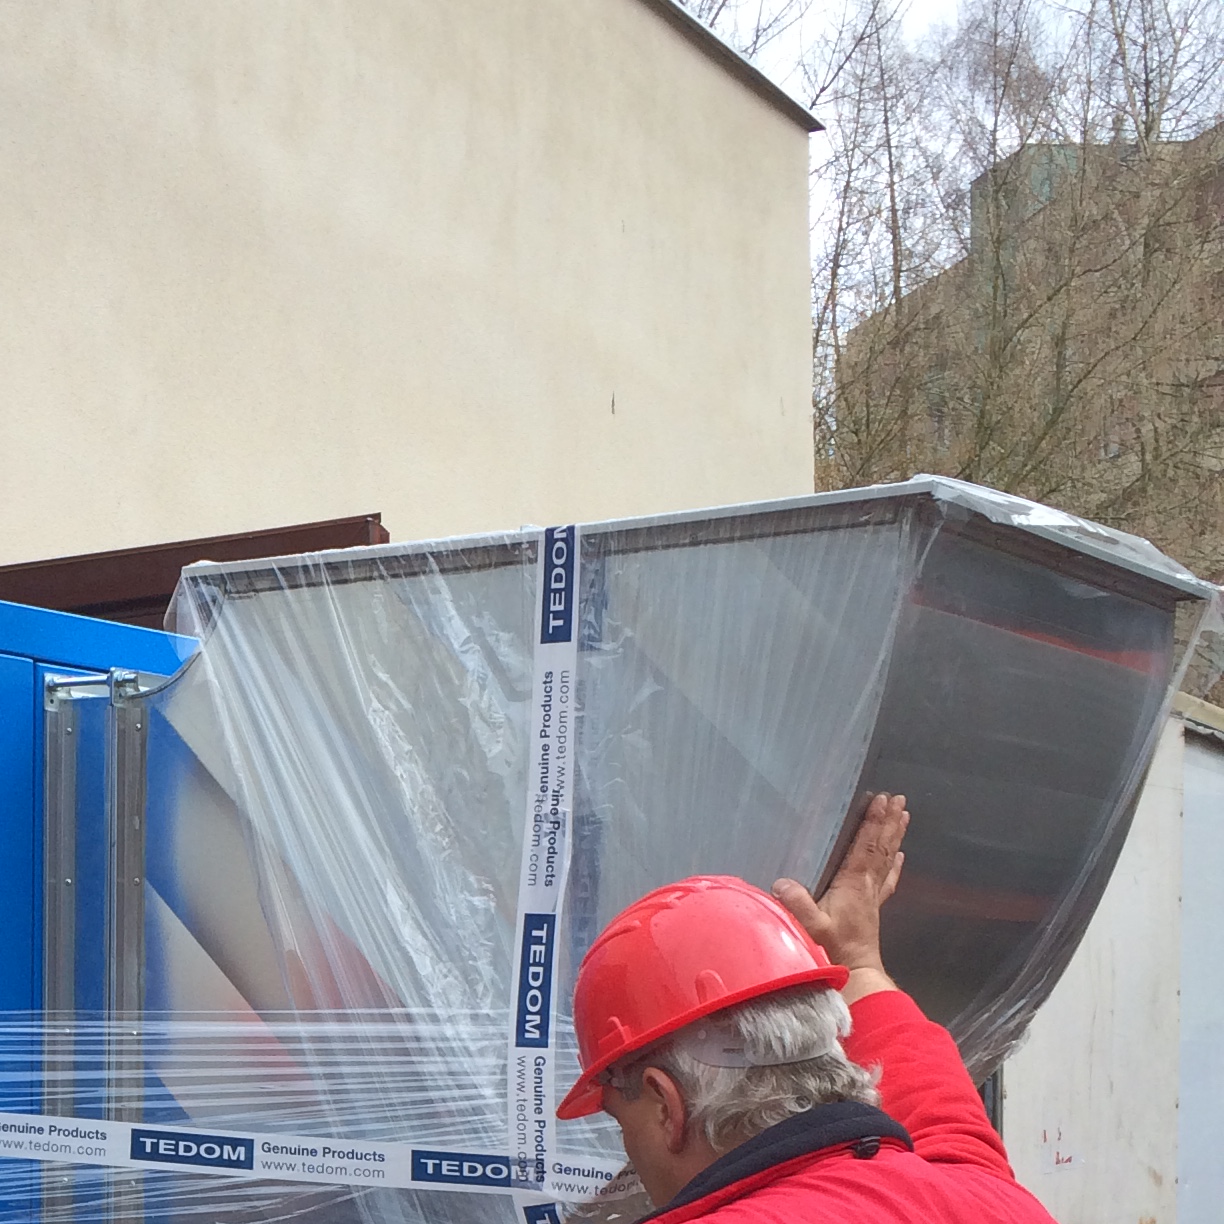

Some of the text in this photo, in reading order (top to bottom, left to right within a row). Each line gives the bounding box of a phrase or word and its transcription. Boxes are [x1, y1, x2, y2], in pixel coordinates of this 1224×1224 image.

[539, 671, 554, 739] Products
[544, 823, 561, 887] Products
[524, 923, 548, 1039] TEDOM
[515, 1055, 528, 1183] www.tedom.com
[533, 1055, 547, 1183] Genuine Products
[49, 1125, 107, 1141] Products
[140, 1137, 246, 1161] TEDOM
[261, 1142, 385, 1163] Genuine Products
[261, 1160, 385, 1179] www.tedom.com
[420, 1158, 535, 1182] TEDOM
[552, 1162, 613, 1181] Genuine
